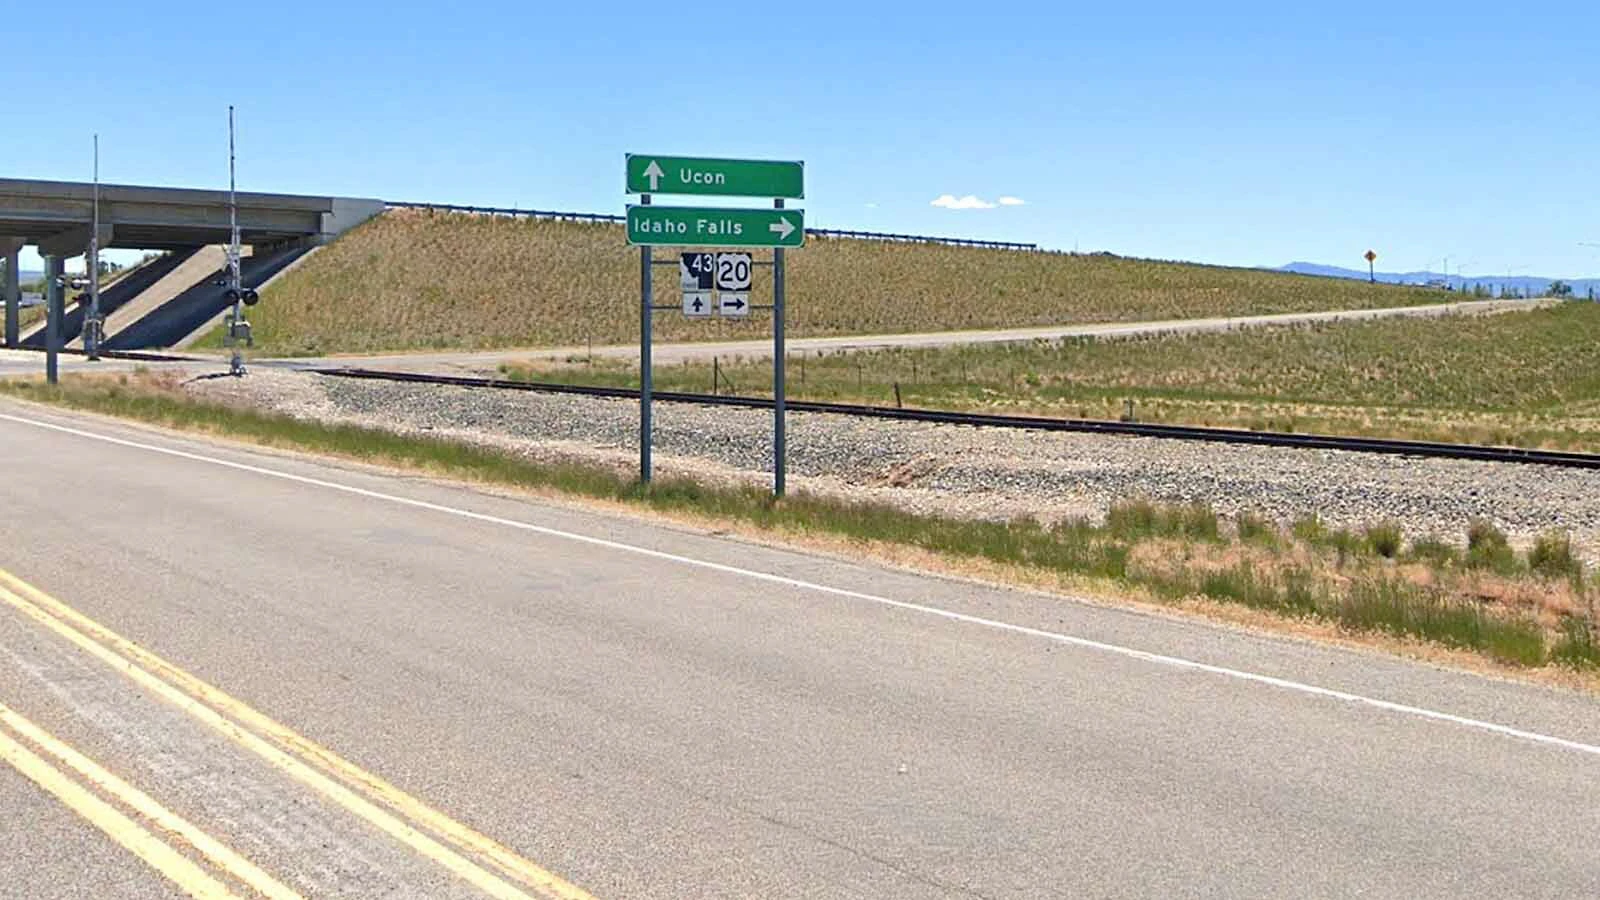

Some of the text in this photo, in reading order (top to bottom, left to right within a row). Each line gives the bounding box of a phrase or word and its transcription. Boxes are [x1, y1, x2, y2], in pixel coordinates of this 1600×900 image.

[680, 168, 725, 185] Ucon
[634, 218, 742, 235] Idaho Falls
[692, 254, 713, 272] 43
[720, 261, 748, 281] 20
